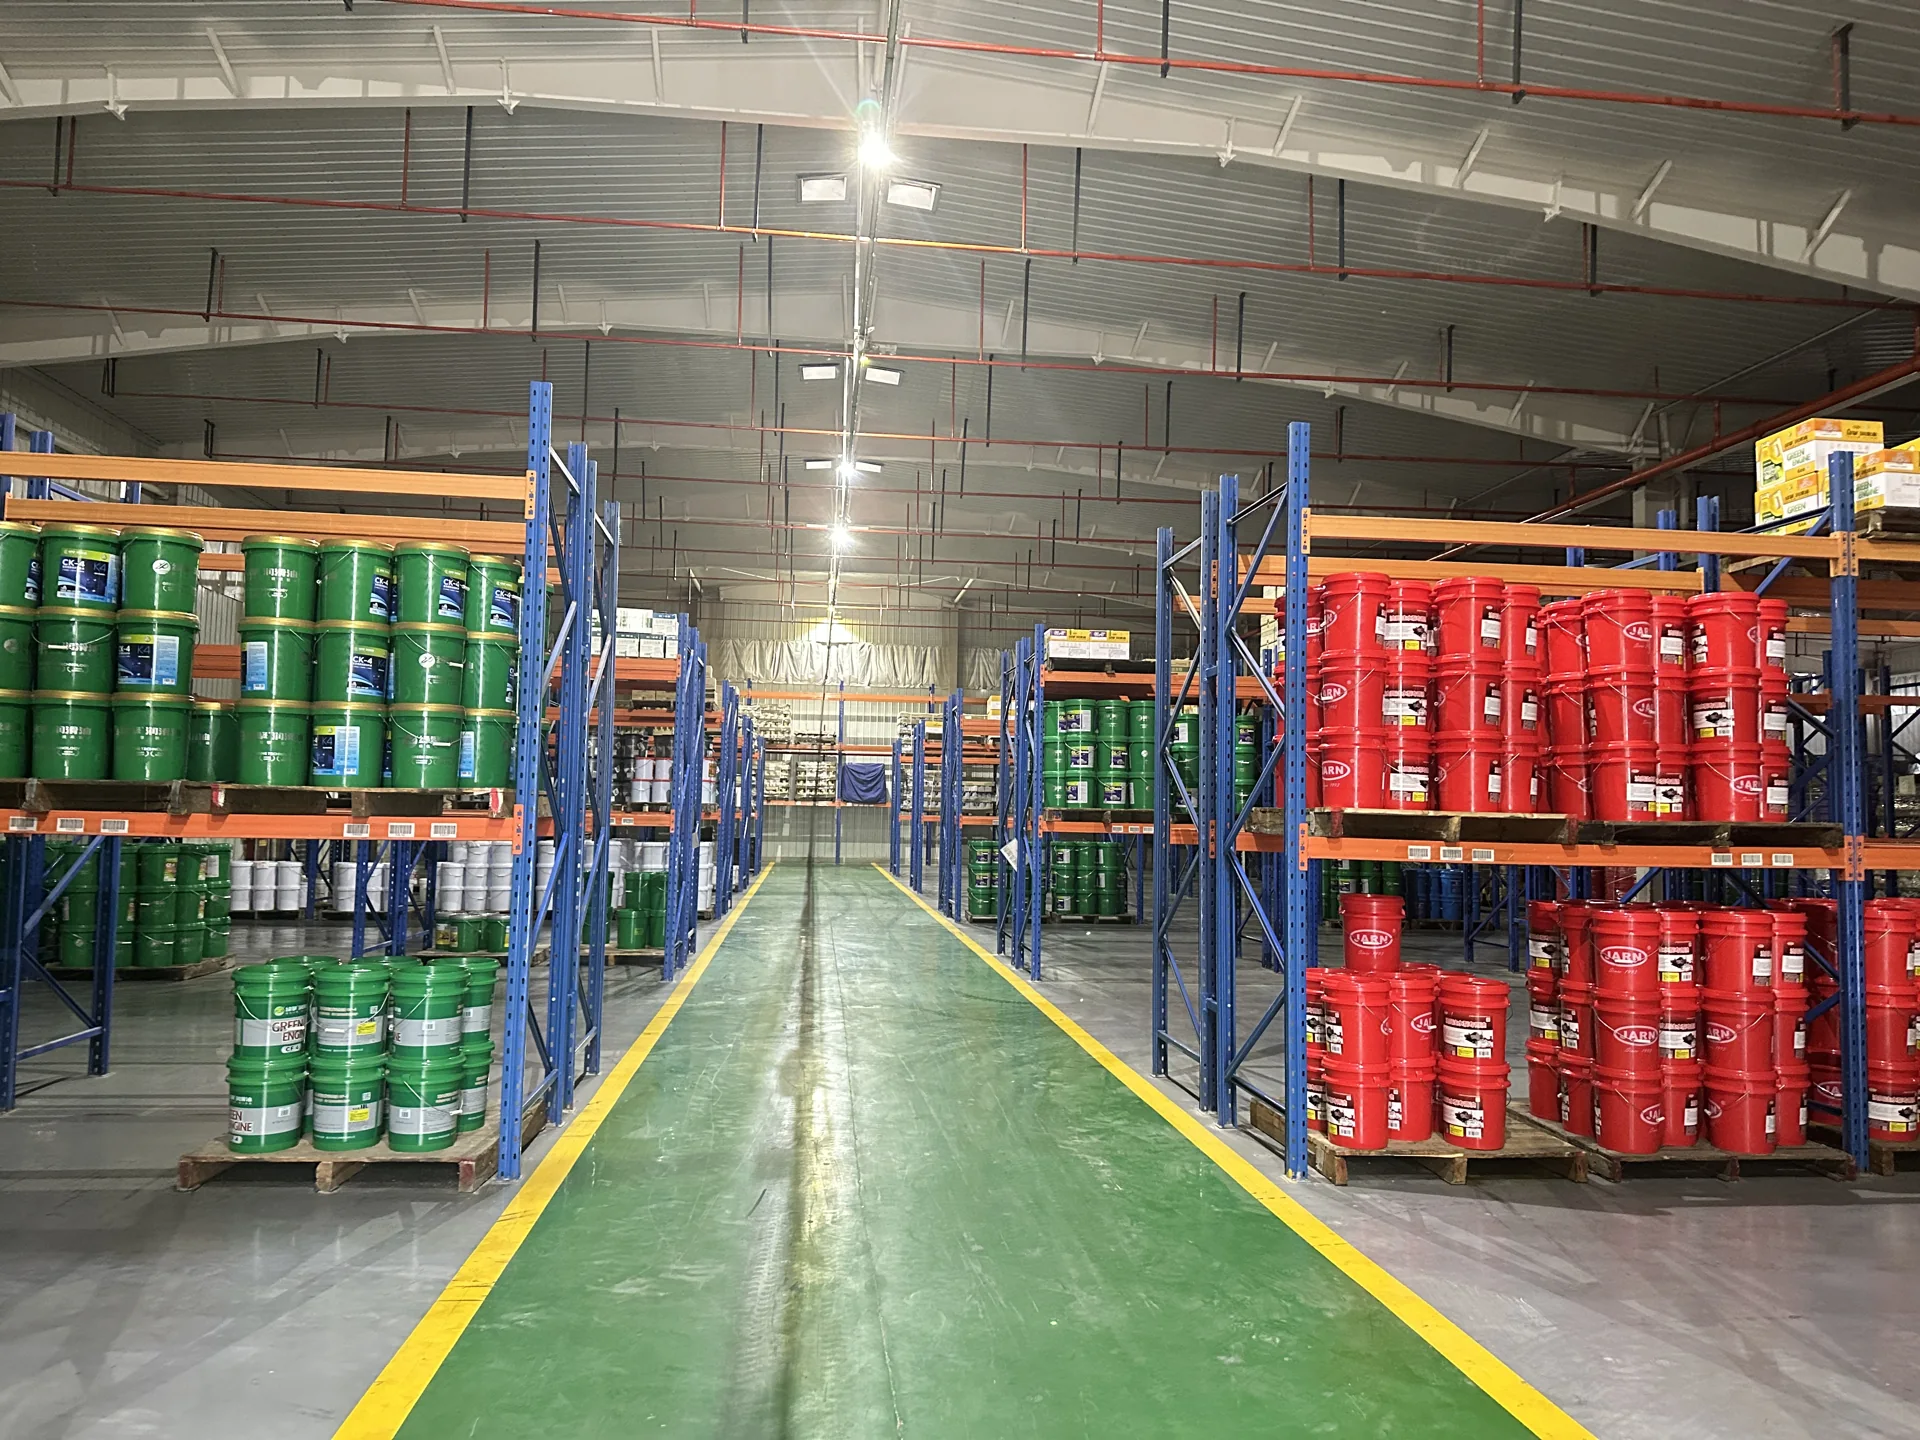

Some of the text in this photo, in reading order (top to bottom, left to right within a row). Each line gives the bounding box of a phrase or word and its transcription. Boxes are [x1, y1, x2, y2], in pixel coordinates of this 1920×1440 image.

[61, 559, 86, 568] CK-4
[443, 578, 460, 588] CK-4
[352, 655, 373, 665] CK-4
[1322, 765, 1344, 775] ARN
[1353, 933, 1388, 944] JARN
[1604, 950, 1643, 962] JARN
[1619, 1030, 1656, 1041] JARN
